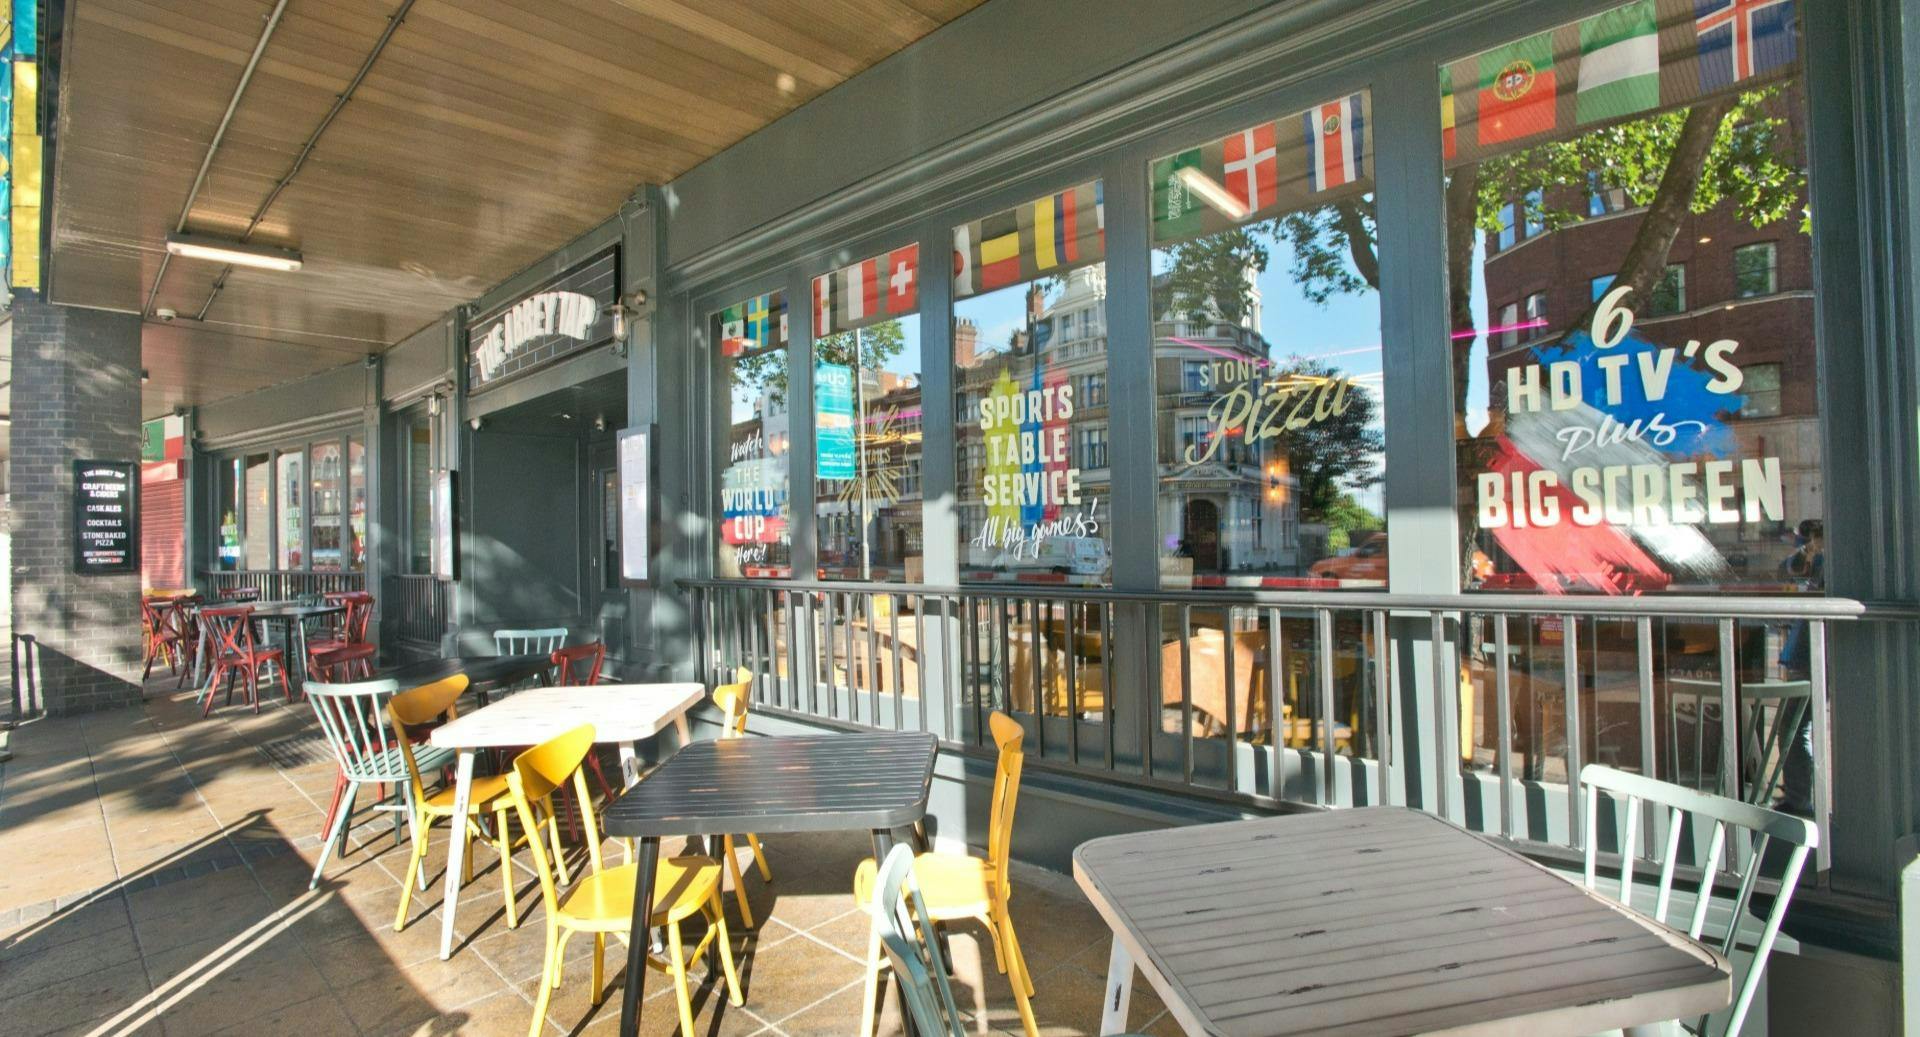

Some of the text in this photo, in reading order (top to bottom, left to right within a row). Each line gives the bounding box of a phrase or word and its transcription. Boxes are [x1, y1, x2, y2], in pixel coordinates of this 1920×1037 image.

[476, 290, 596, 381] THE ABBEY TAP
[1591, 285, 1634, 349] 6
[1200, 356, 1262, 386] STONE
[980, 384, 1074, 430] SPORTS
[1184, 374, 1352, 465] Pizza
[990, 427, 1066, 466] TABLE
[1556, 413, 1707, 461] plus
[736, 466, 761, 483] THE
[984, 468, 1081, 506] SERVICE
[1477, 457, 1784, 529] BIG SCREEN
[721, 487, 774, 513] WORLD
[87, 519, 122, 527] COCKTAILS
[735, 515, 765, 540] CUP
[971, 497, 1099, 560] All big games!
[95, 539, 115, 547] PIZZA
[736, 543, 767, 565] Here!
